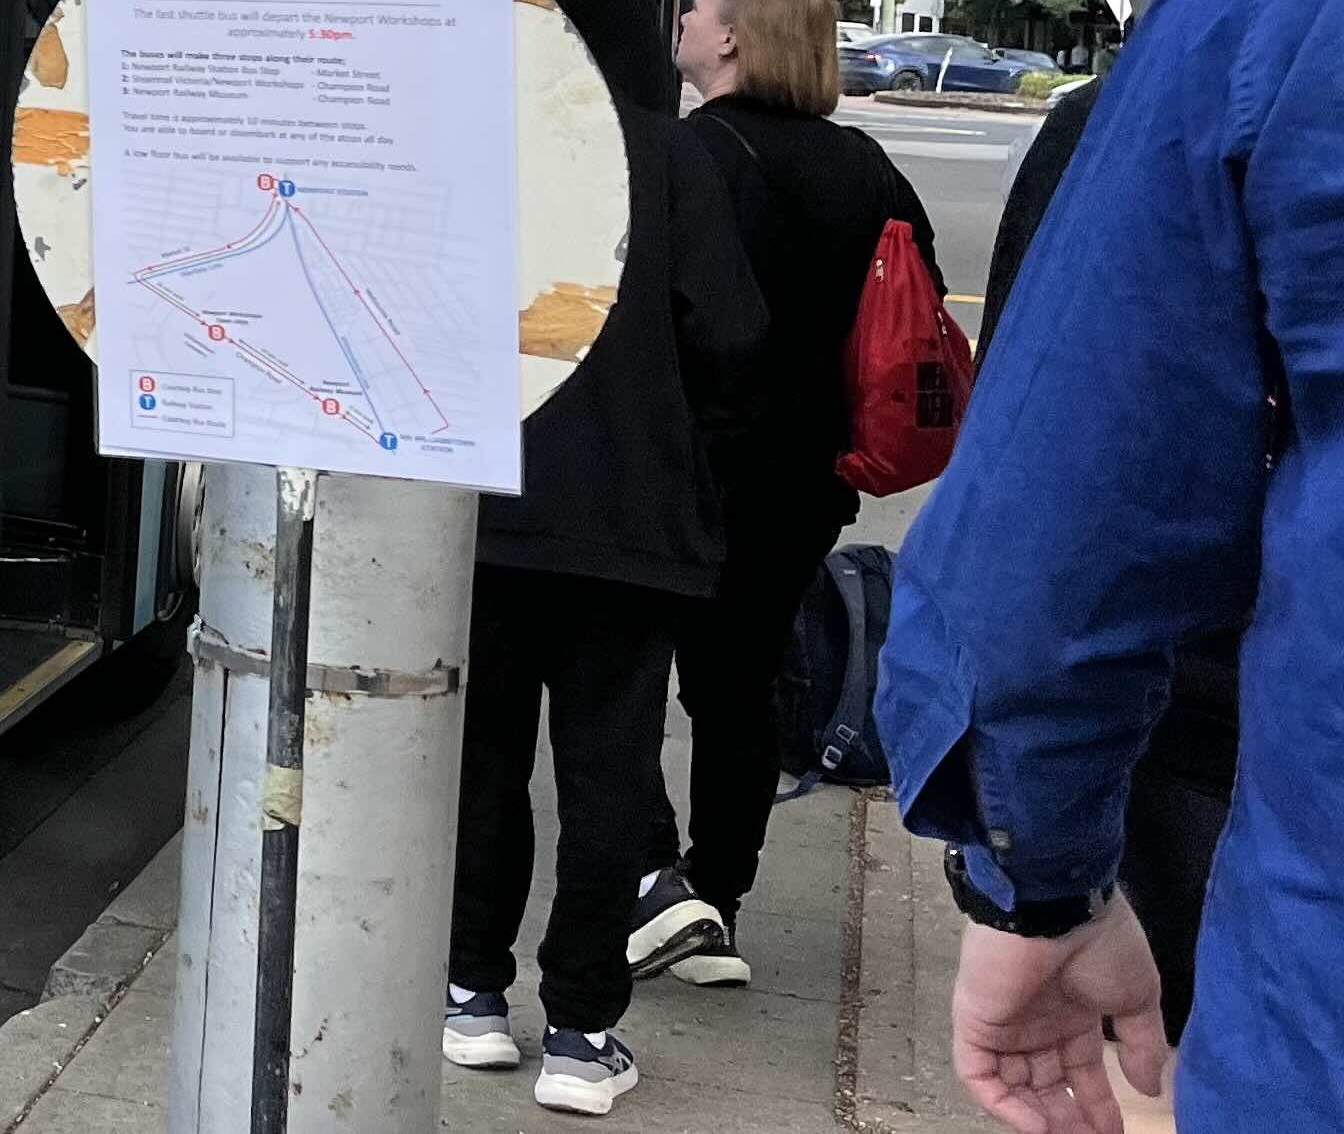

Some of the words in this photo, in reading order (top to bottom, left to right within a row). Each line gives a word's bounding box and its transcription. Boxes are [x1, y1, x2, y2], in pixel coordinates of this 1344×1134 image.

[134, 8, 153, 19] The
[178, 9, 215, 20] shuttle
[218, 10, 238, 20] bus
[324, 14, 374, 26] Newport
[377, 15, 442, 27] Workshops
[227, 28, 304, 42] approximately
